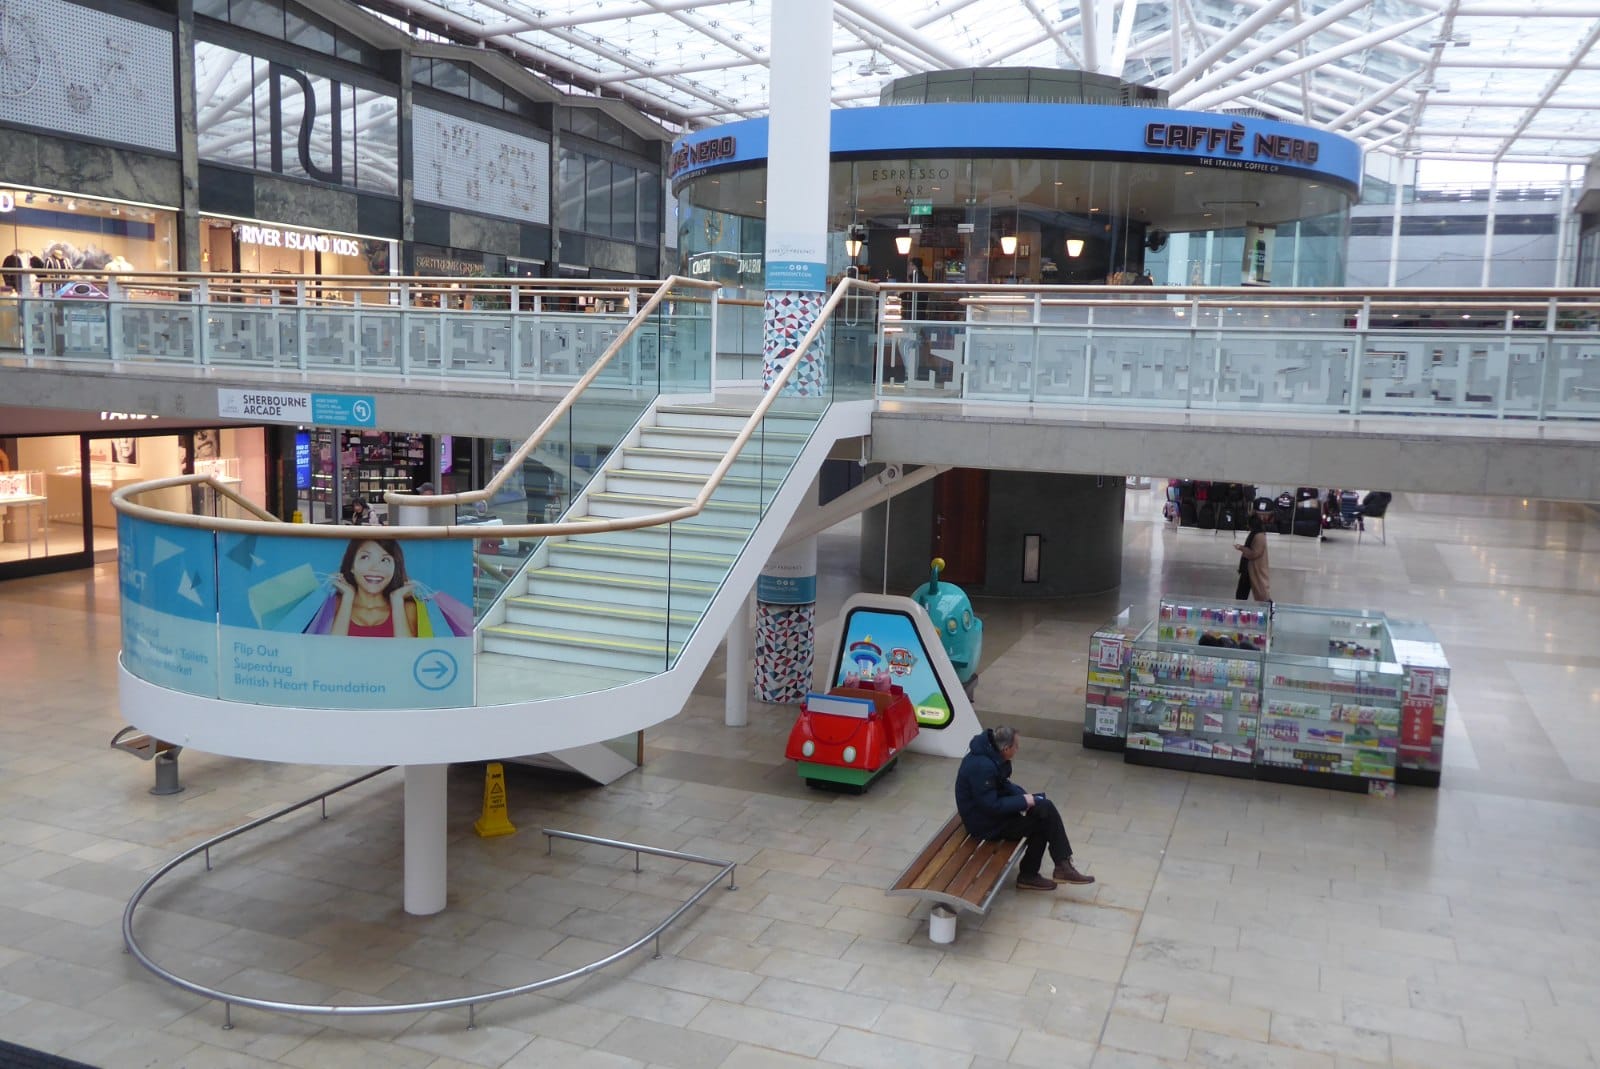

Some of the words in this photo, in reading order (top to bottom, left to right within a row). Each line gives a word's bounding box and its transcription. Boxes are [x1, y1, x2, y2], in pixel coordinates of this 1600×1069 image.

[1145, 121, 1246, 153] CAFFÈ
[1254, 132, 1320, 164] NERO
[689, 136, 737, 165] NERO
[1200, 157, 1212, 166] THE
[1215, 159, 1242, 168] ITALIAN
[1244, 162, 1270, 171] COFFEE
[872, 168, 950, 180] ESPRESSO
[895, 185, 924, 197] BAR
[241, 225, 281, 247] RIVER
[284, 231, 330, 252] ISLAND
[333, 238, 359, 257] KIDS
[243, 394, 307, 407] SHERBOURNE
[243, 405, 281, 416] ARCADE
[233, 642, 253, 657] Flip
[256, 645, 279, 657] Out
[233, 658, 293, 676] Superdrug
[234, 673, 270, 688] British
[273, 678, 308, 691] Heart
[312, 680, 386, 694] Foundation
